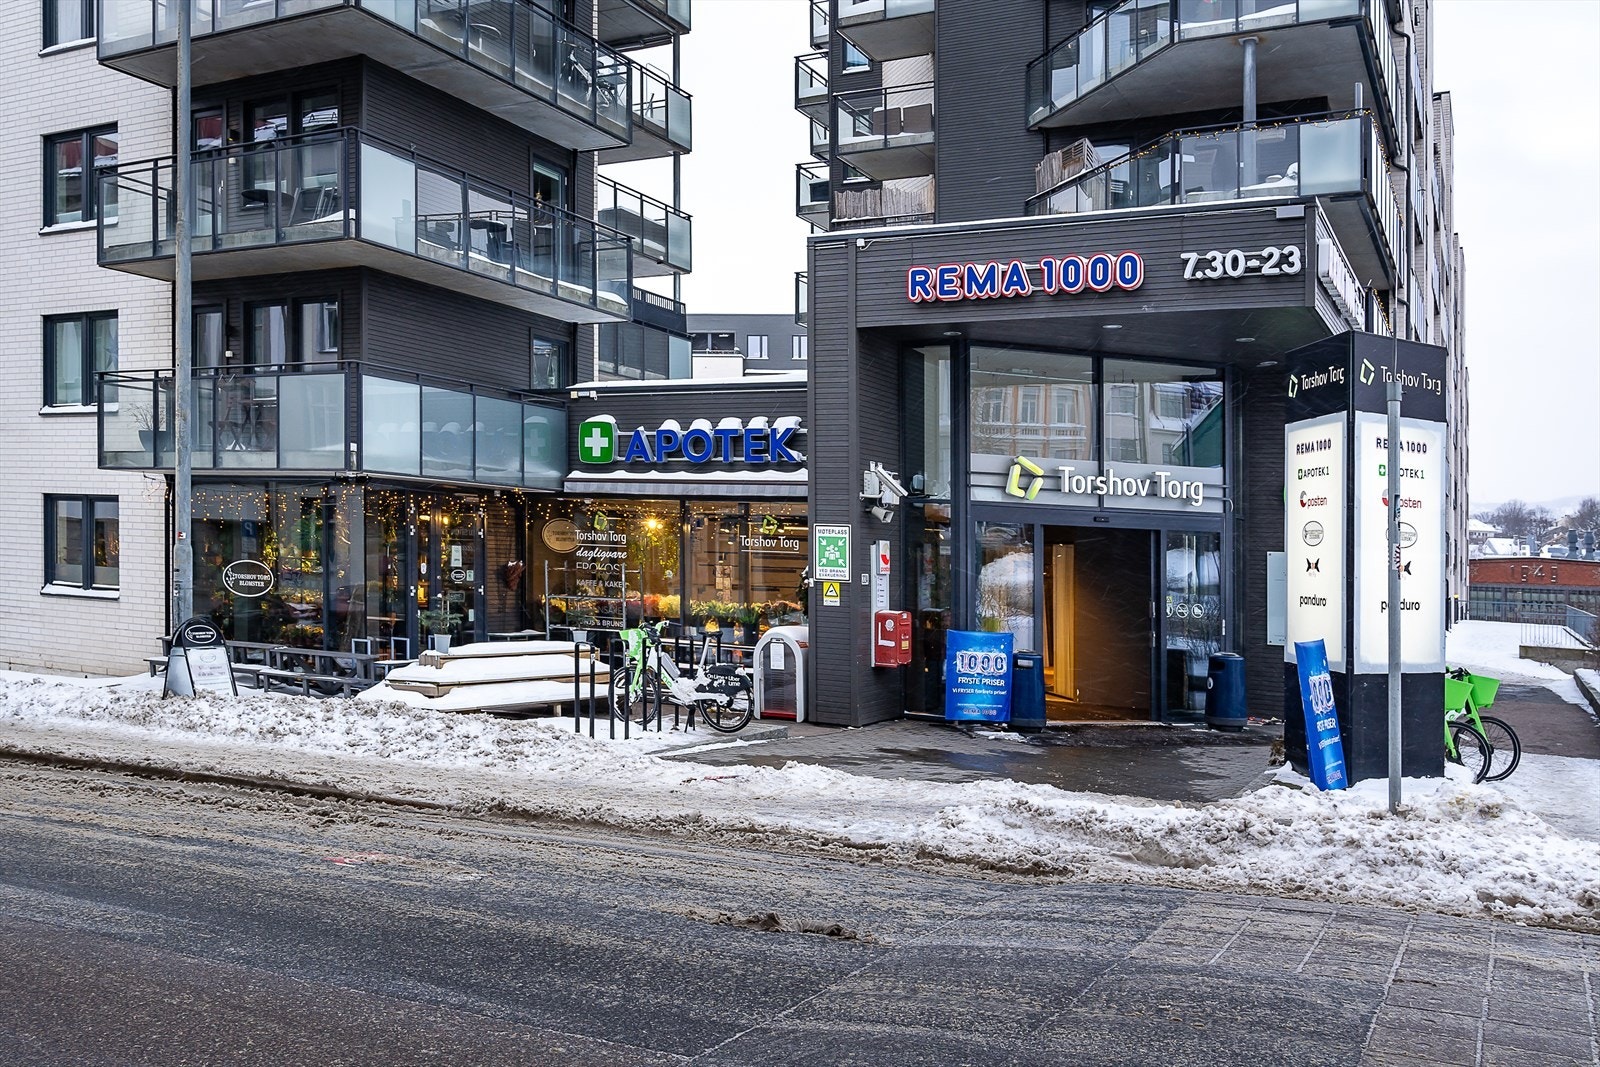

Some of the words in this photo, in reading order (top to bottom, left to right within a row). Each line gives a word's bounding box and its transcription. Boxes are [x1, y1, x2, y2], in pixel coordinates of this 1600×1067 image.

[1180, 245, 1302, 280] 7.30-23
[907, 259, 1032, 304] REMA
[1040, 251, 1144, 295] 1000
[1301, 371, 1328, 391] Torshov
[1328, 365, 1345, 385] Torg
[1421, 372, 1442, 396] Torg
[624, 427, 801, 464] APOTEK
[1296, 441, 1315, 456] REMA
[1316, 438, 1332, 452] 1000
[1376, 437, 1404, 451] REA
[1406, 441, 1427, 454] 1000
[1303, 466, 1325, 478] APOTEK
[1326, 465, 1330, 476] 1
[1420, 469, 1425, 479] 1
[1058, 466, 1151, 497] Torshov
[1154, 471, 1204, 507] Torg
[1306, 496, 1328, 509] posten
[1399, 497, 1422, 508] osten
[575, 529, 607, 541] Torshov
[608, 530, 627, 544] Torg
[740, 535, 777, 547] Torshov
[778, 536, 799, 551] Torg
[576, 547, 627, 561] dagligvare
[576, 579, 597, 587] KAFFE
[604, 580, 625, 588] KAKE
[1299, 594, 1327, 607] panduro
[1381, 598, 1420, 613] pduro
[957, 652, 1006, 673] 1000
[958, 676, 980, 685] FRYSTE
[981, 678, 1005, 687] PRISER
